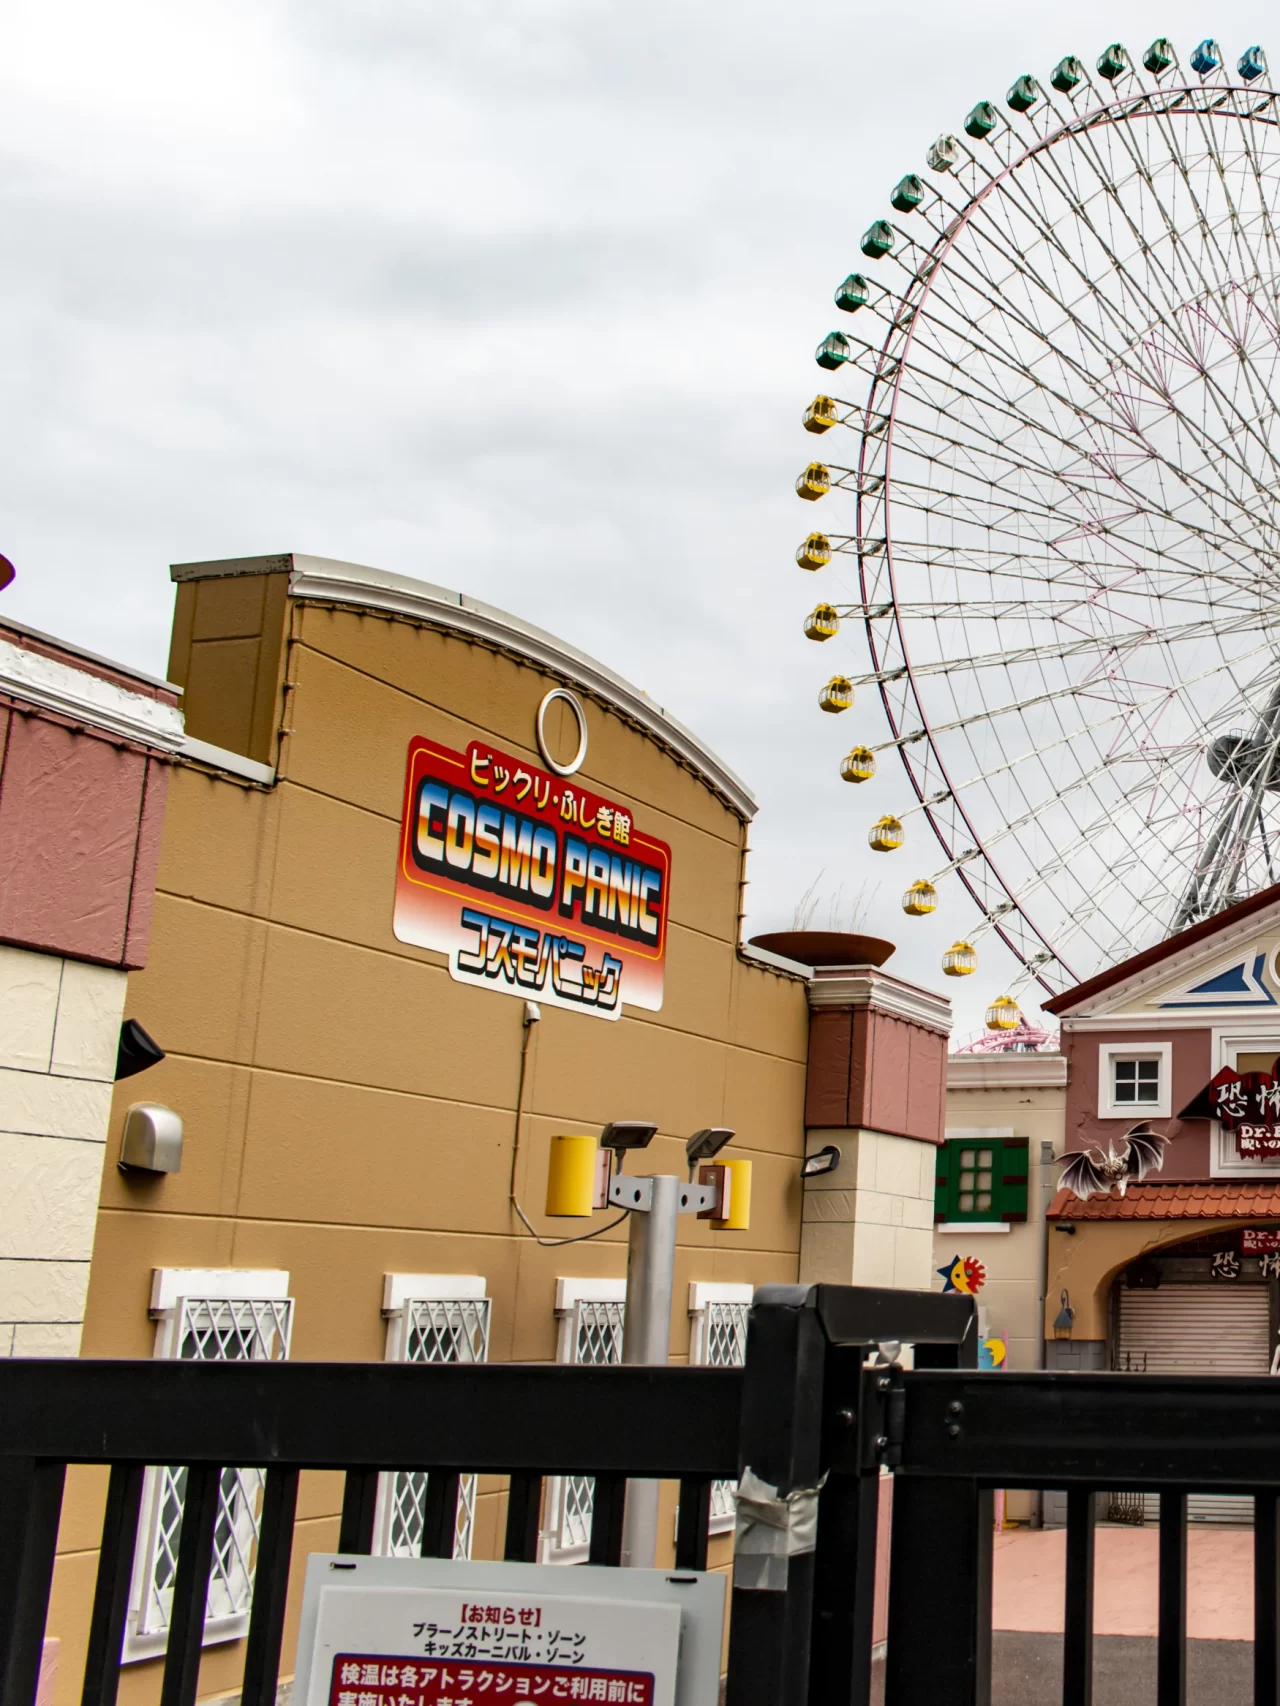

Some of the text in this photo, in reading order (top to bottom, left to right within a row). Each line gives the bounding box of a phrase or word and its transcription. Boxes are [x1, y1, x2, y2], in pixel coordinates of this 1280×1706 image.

[470, 748, 631, 845] ビックリ・ふしぎ館
[416, 781, 661, 936] COSMO PANIC
[457, 907, 623, 1010] コスモパニック
[412, 1622, 587, 1647] ブラーノストリート・ゾーン
[460, 1603, 542, 1627] 【お知らせ】
[424, 1640, 585, 1664] キッズカーニバル・ゾーン
[340, 1662, 645, 1702] 検温は各アトラクションご利用前に
